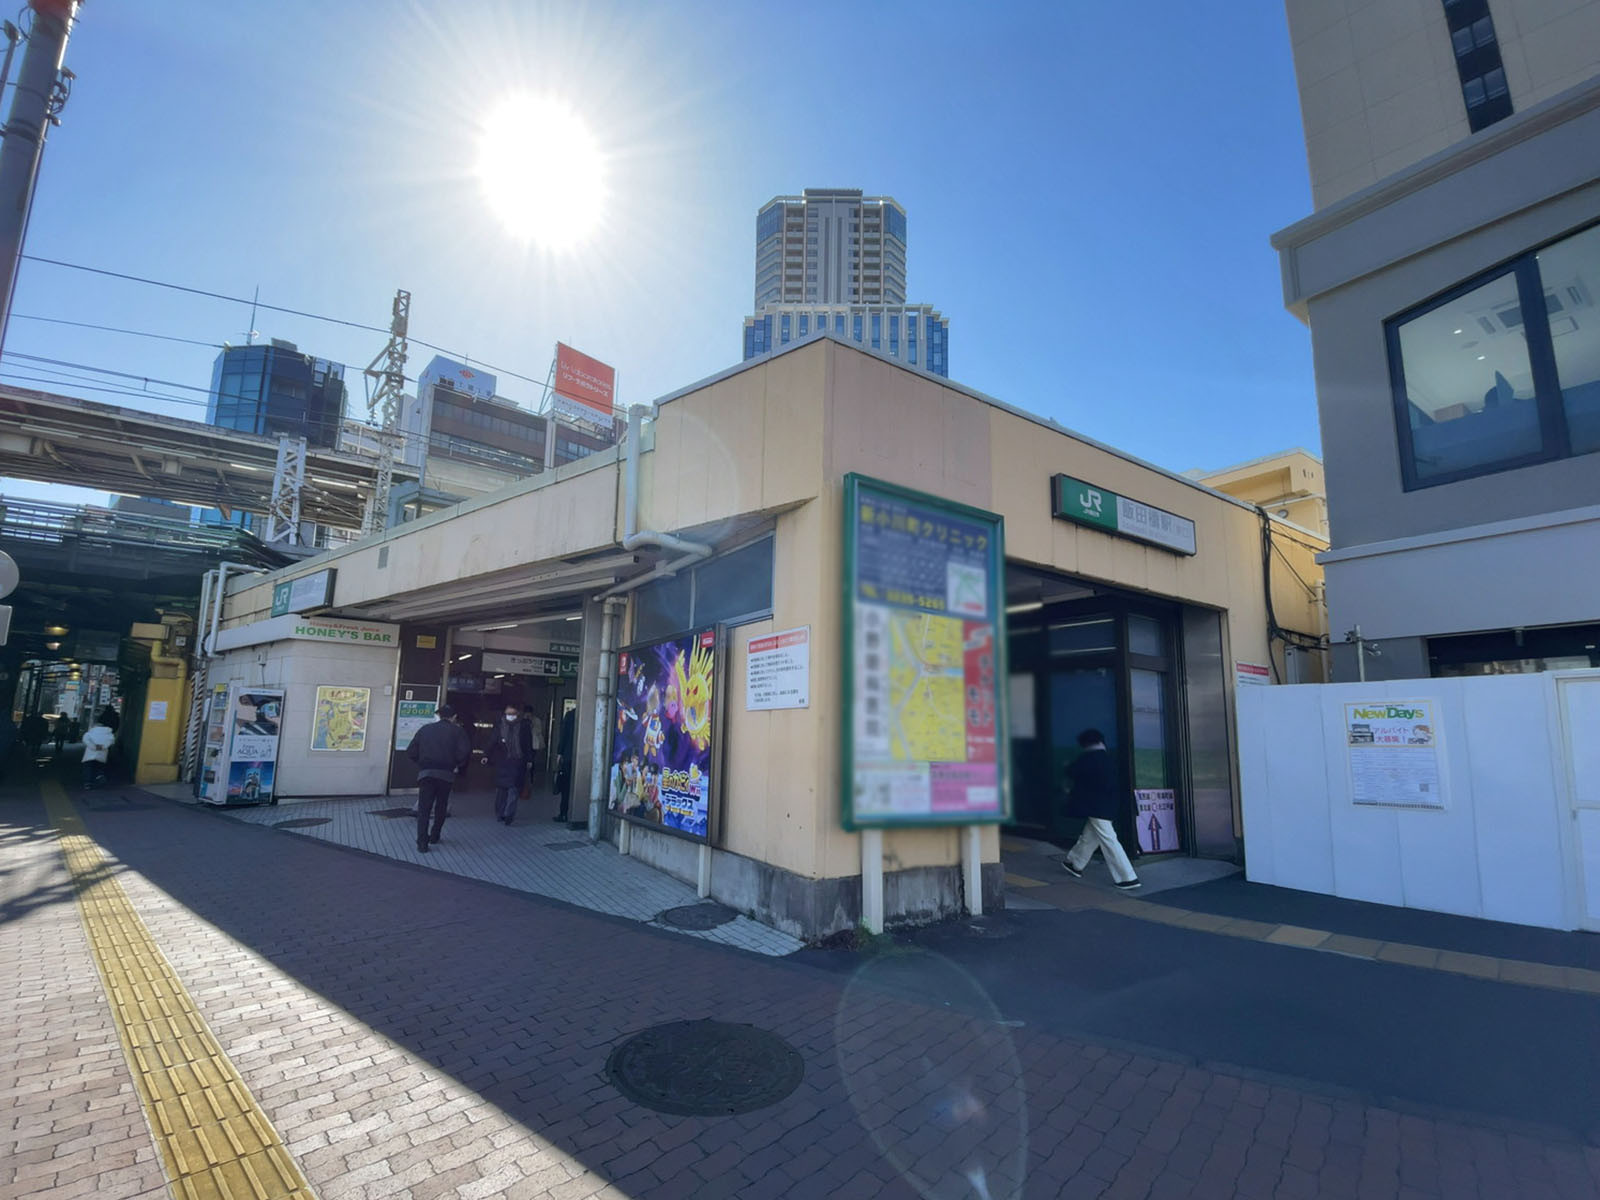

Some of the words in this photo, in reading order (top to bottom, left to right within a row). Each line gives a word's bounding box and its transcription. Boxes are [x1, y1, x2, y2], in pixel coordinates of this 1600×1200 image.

[1080, 489, 1103, 513] JR
[275, 587, 290, 606] JR
[295, 625, 359, 640] HONEY'S
[363, 631, 392, 643] BAR
[1353, 707, 1425, 720] NewDays
